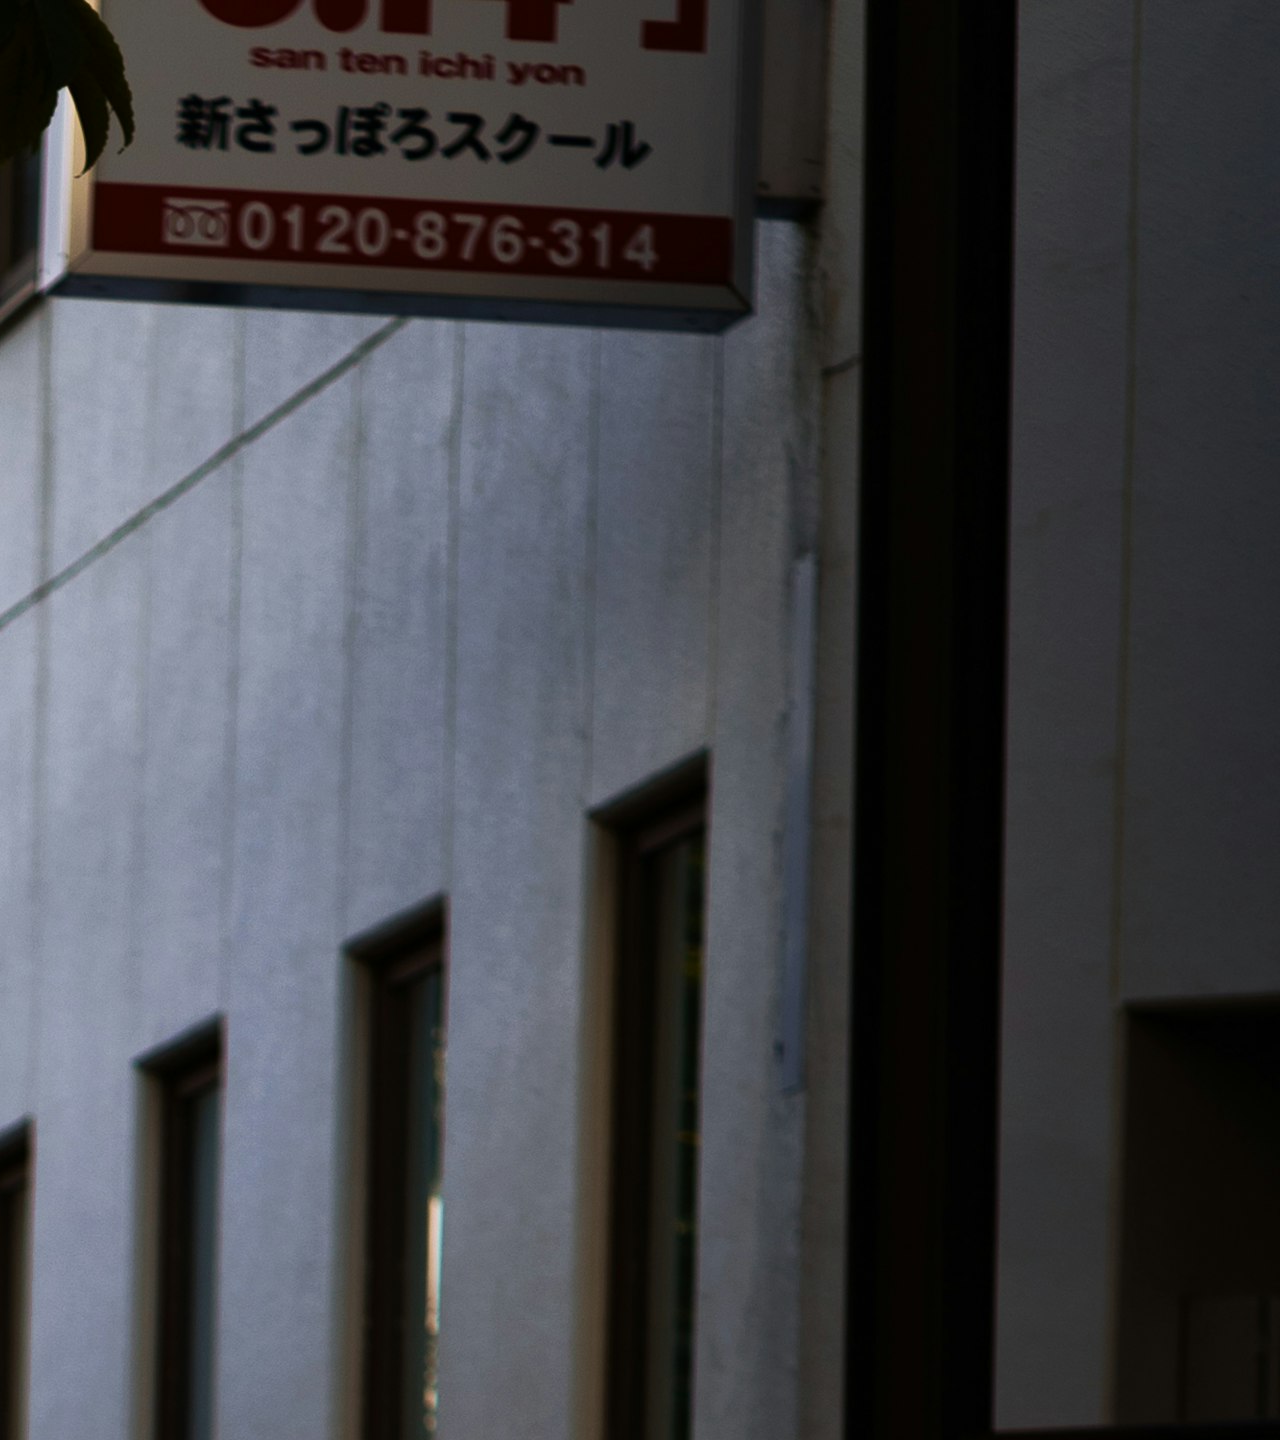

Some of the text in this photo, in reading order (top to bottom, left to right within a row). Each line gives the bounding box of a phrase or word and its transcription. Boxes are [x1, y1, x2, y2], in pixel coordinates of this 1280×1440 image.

[249, 45, 586, 87] san ten ichi yon
[177, 94, 651, 169] 新さっぽろスクール
[238, 200, 660, 272] 0120-876-314
